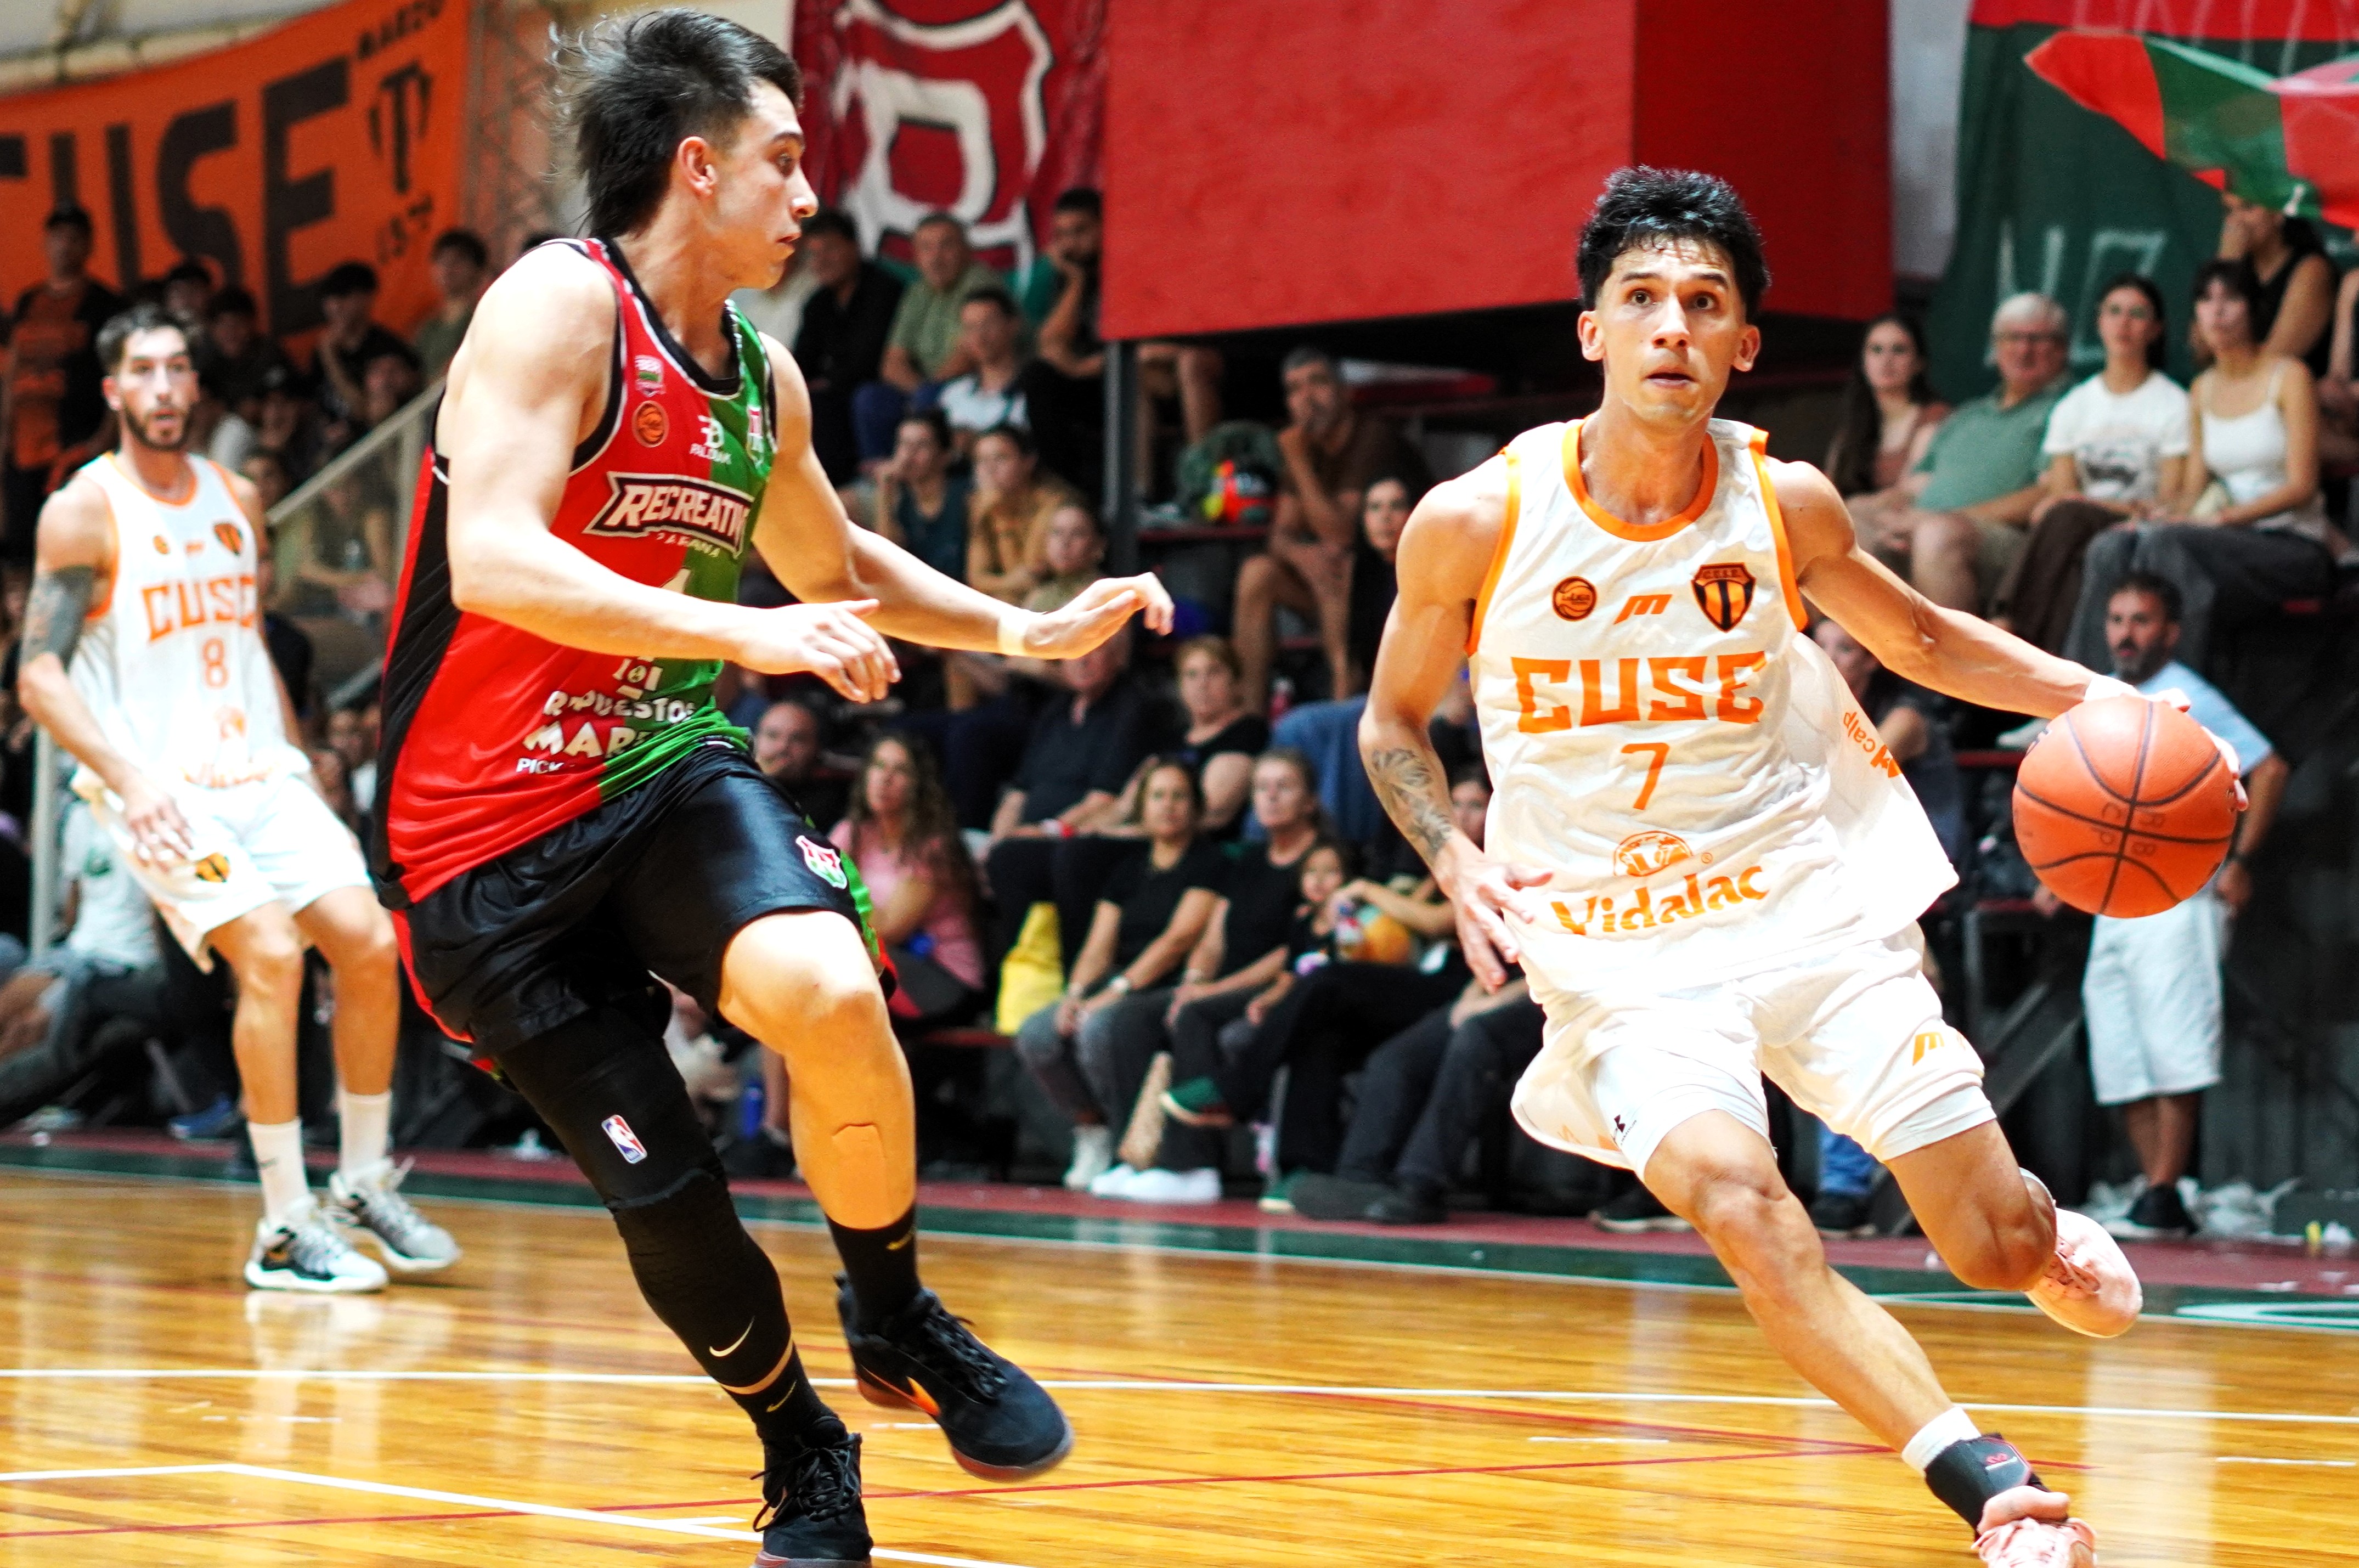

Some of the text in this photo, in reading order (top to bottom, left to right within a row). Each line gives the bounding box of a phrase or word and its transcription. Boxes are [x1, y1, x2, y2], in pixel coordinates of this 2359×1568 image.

[202, 636, 229, 689] 8
[1511, 650, 1768, 734] CUSE
[1621, 742, 1670, 810] 7
[1550, 865, 1769, 936] Vidalac
